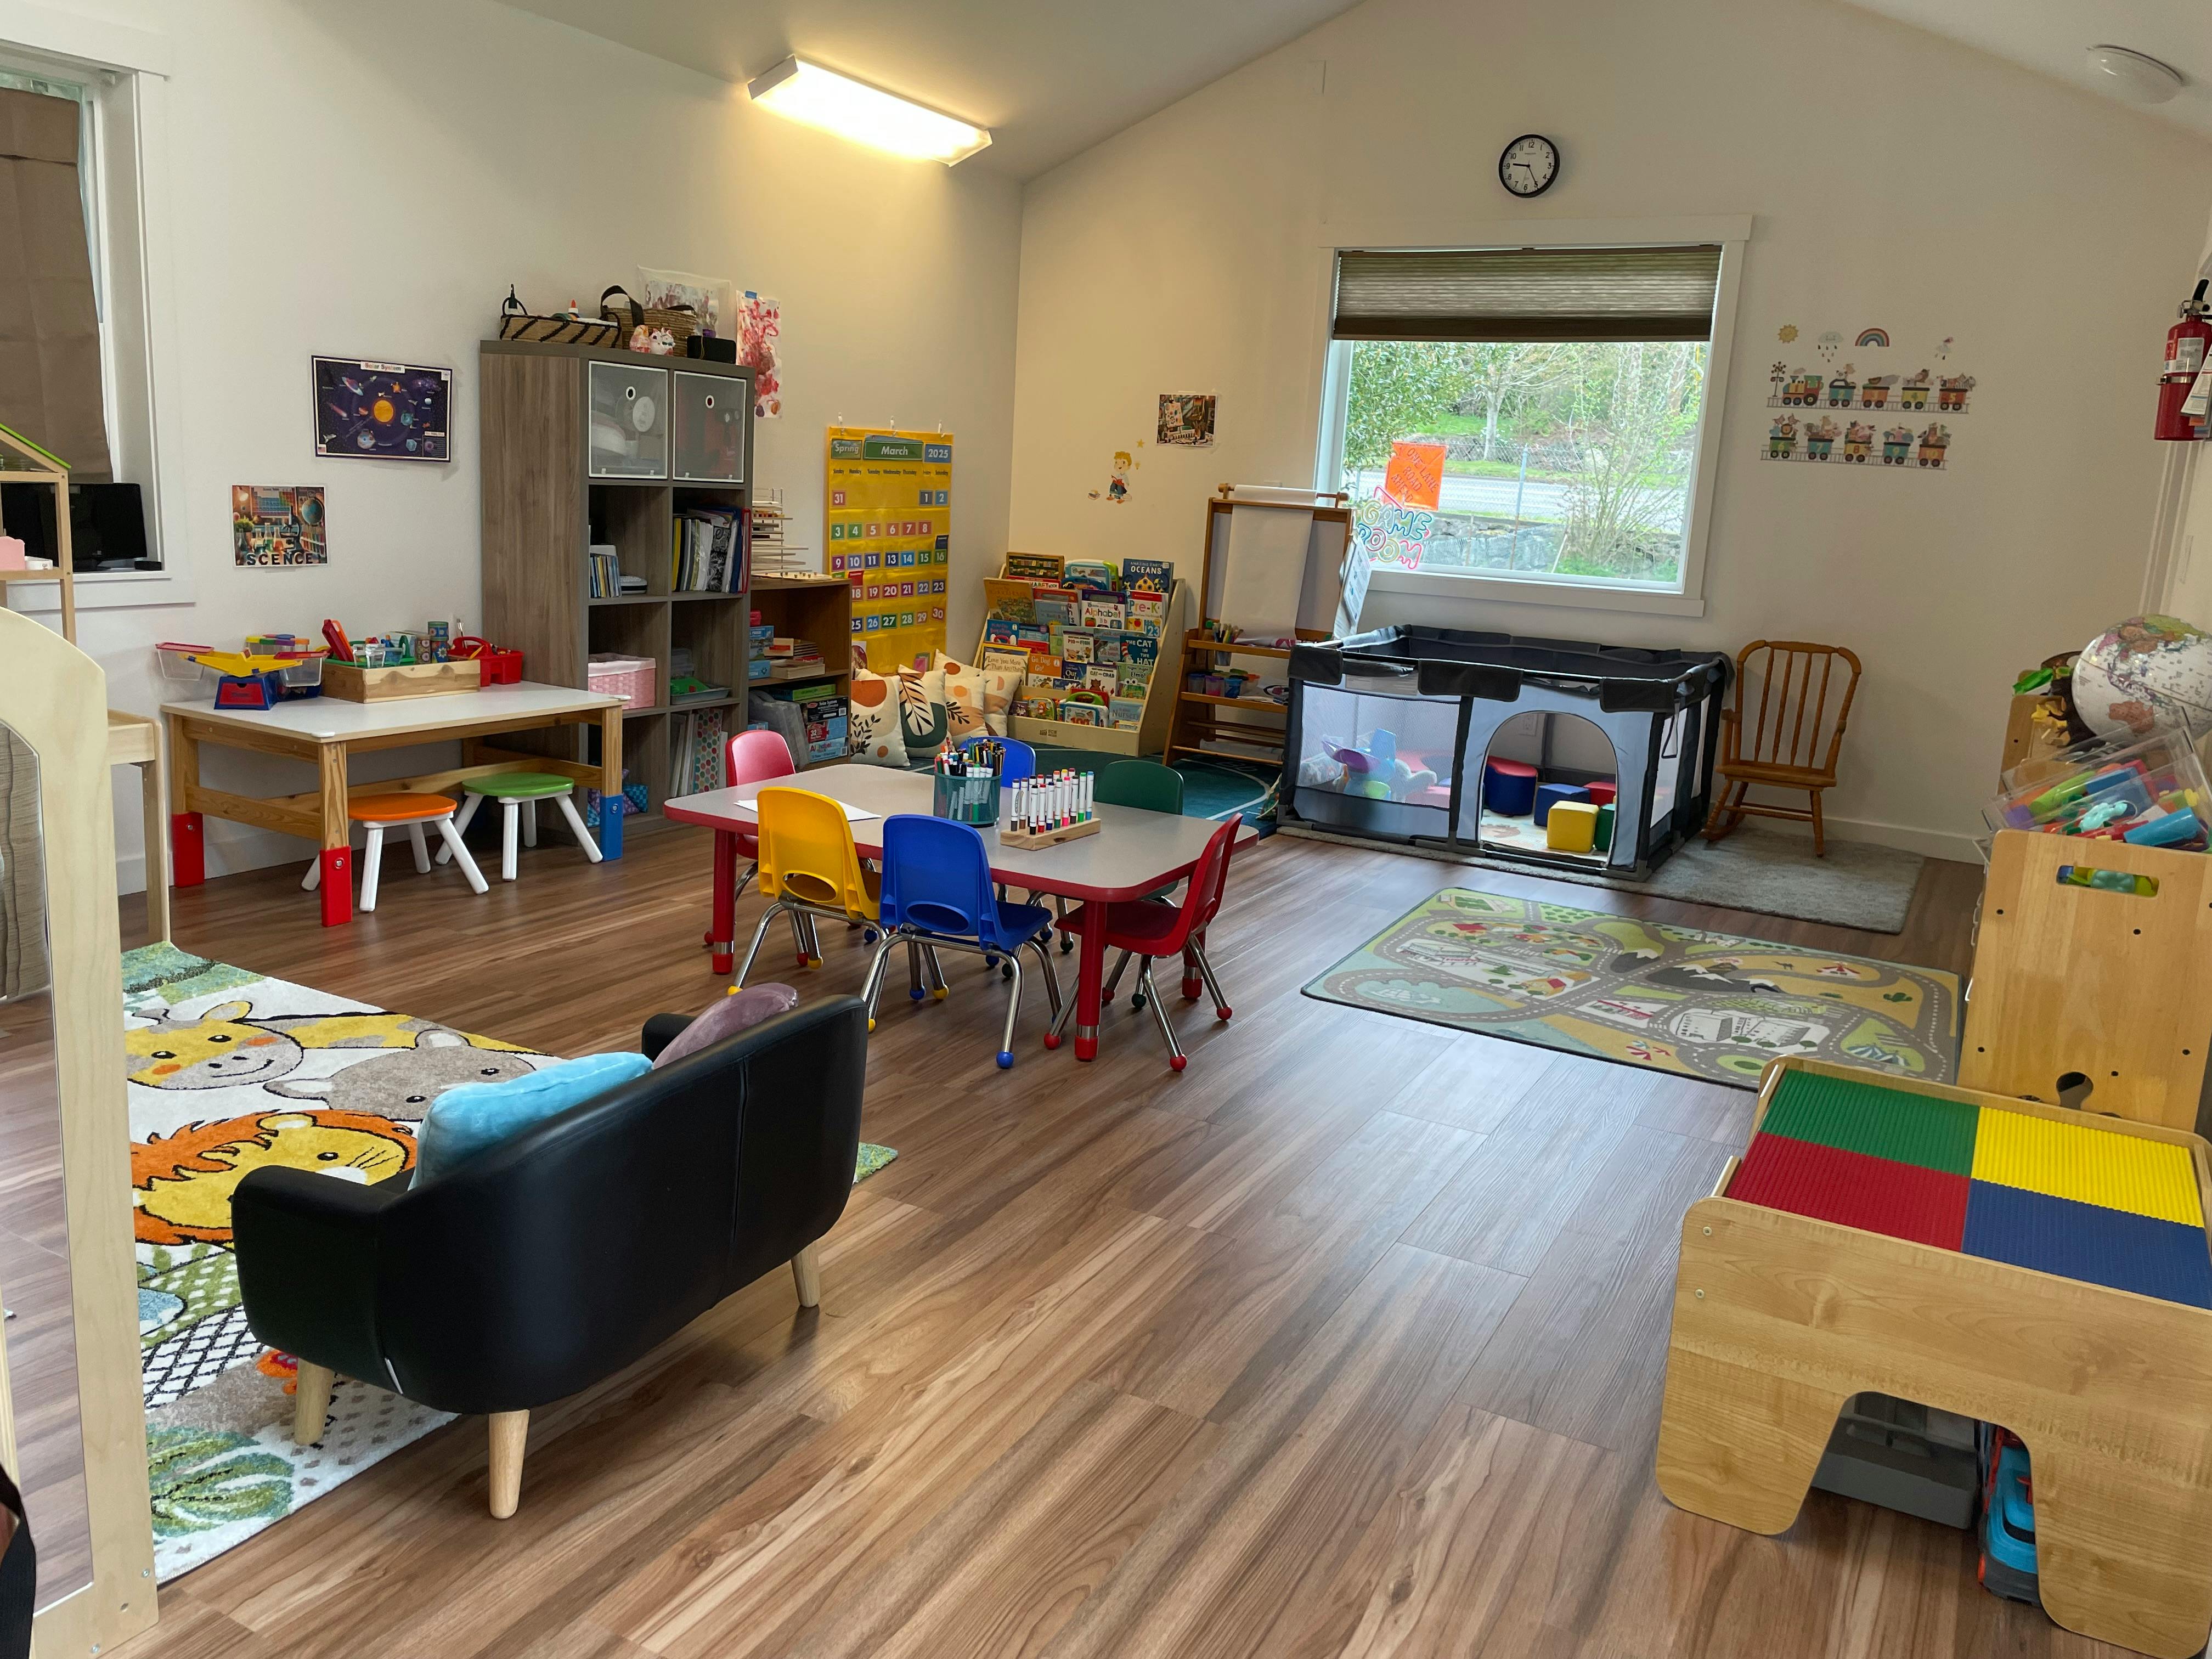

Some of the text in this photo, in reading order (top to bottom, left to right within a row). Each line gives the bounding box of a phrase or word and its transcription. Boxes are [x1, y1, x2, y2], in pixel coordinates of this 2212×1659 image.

[381, 363, 402, 371] System
[1949, 392, 1956, 401] 5
[834, 444, 860, 454] Spring
[881, 445, 909, 456] March
[928, 448, 949, 459] 2025
[1407, 447, 1440, 493] ONE LANE
[1402, 465, 1423, 492] ROAD
[1391, 473, 1414, 503] AHEAD
[834, 493, 944, 504] 31 1 2
[1361, 500, 1434, 541] GAME
[835, 523, 928, 537] 3 4 5 6 7 8
[246, 552, 313, 566] SCENCE
[836, 552, 944, 568] 9 10 11 13 14 15 16
[1131, 566, 1162, 574] OCEANS
[852, 582, 944, 598] 18 19 20 21 22 23
[1085, 607, 1121, 618] Alphabet
[851, 608, 944, 630] 25 26 27 28 29 30
[1137, 640, 1153, 648] CAT
[1137, 657, 1154, 666] HAT
